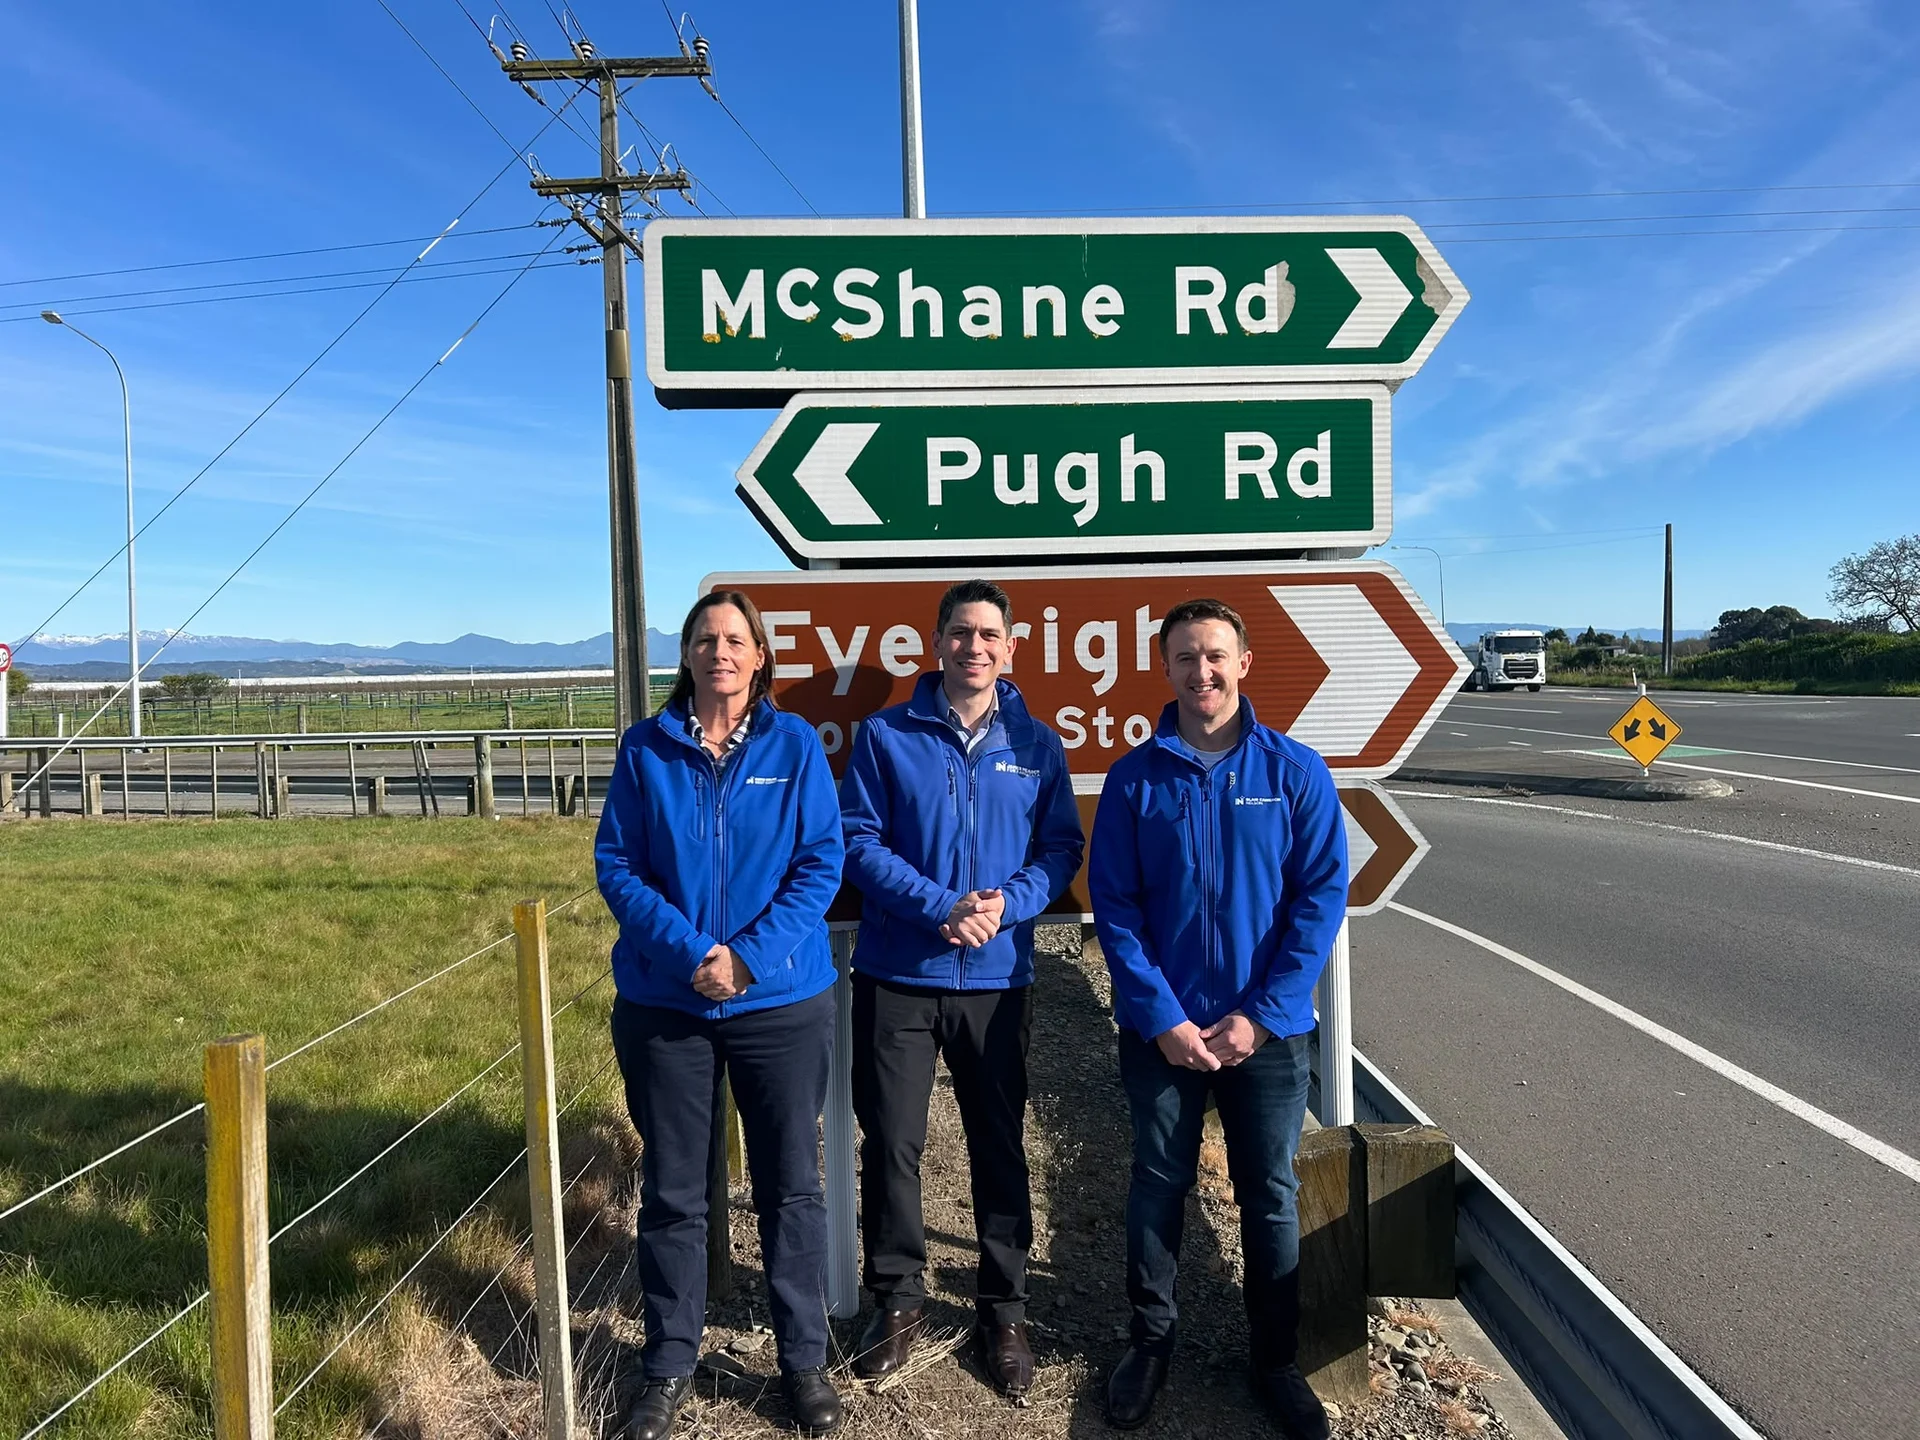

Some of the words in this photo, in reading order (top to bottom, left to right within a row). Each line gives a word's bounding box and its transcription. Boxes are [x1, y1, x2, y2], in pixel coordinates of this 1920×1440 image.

[700, 266, 1126, 343] McShane
[1174, 262, 1287, 336] Rd
[926, 433, 1166, 527] Pugh
[1223, 429, 1333, 501] Rd
[1056, 705, 1152, 749] Sto
